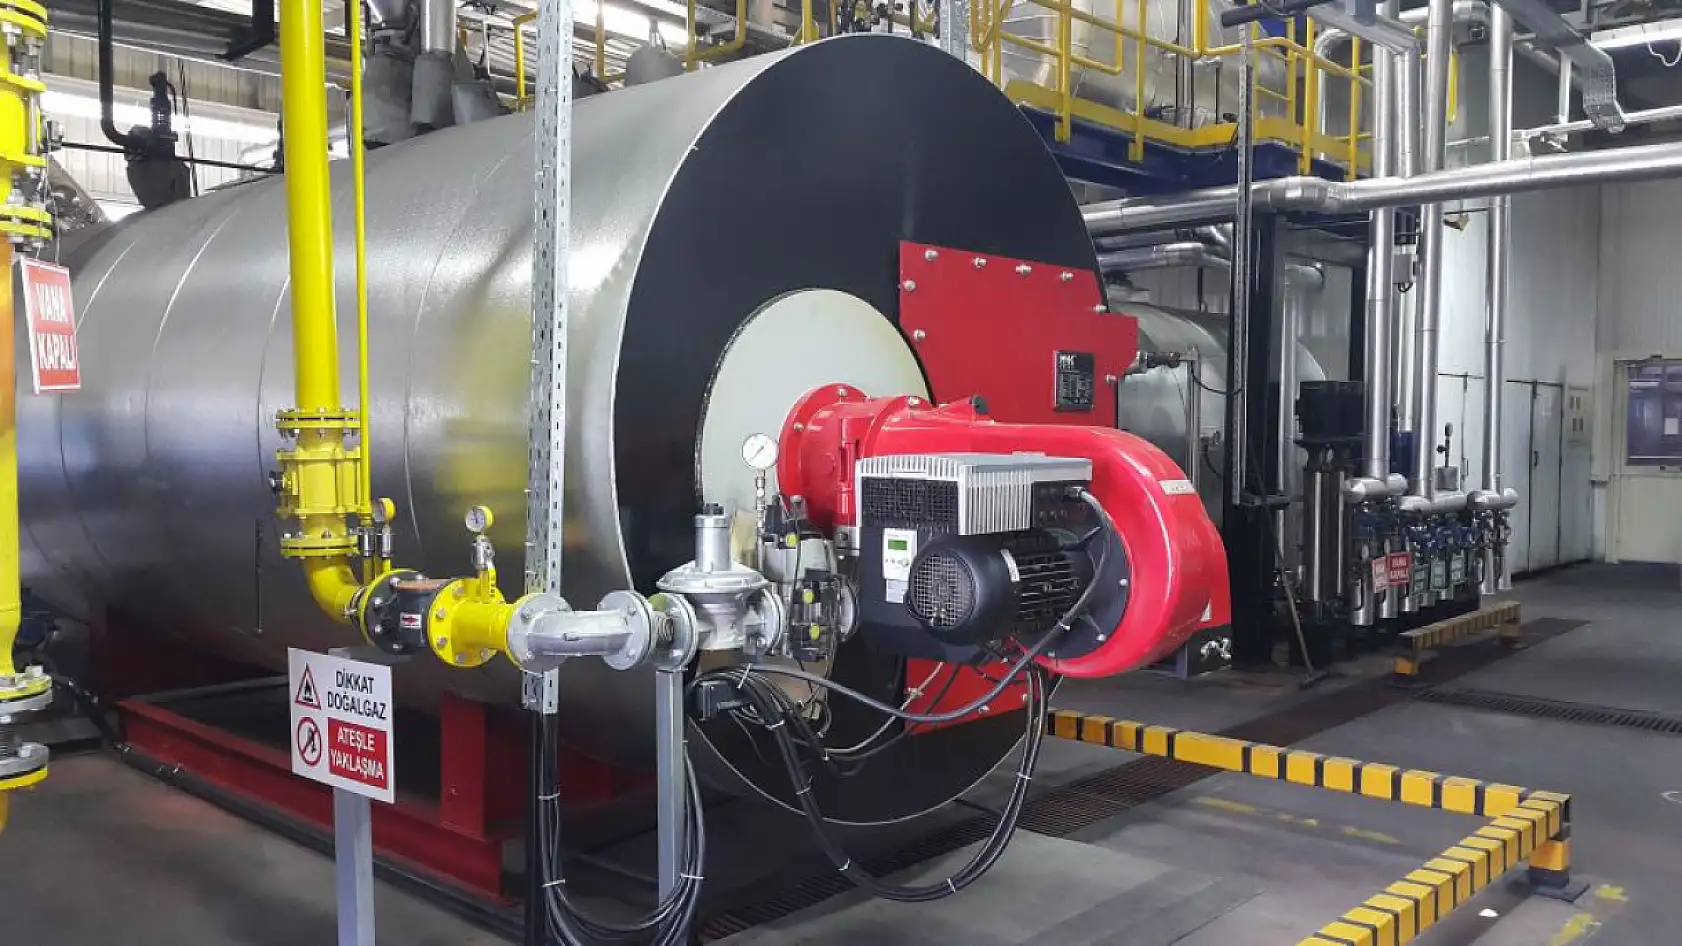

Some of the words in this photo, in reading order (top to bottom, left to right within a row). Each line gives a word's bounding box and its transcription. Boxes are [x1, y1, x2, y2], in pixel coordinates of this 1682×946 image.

[37, 283, 69, 322] VANA
[336, 668, 375, 694] DİKKAT
[328, 691, 387, 720] DOĞALGAZ
[337, 726, 376, 753] ATEŞLE
[330, 748, 384, 780] YAKLAŞMA
